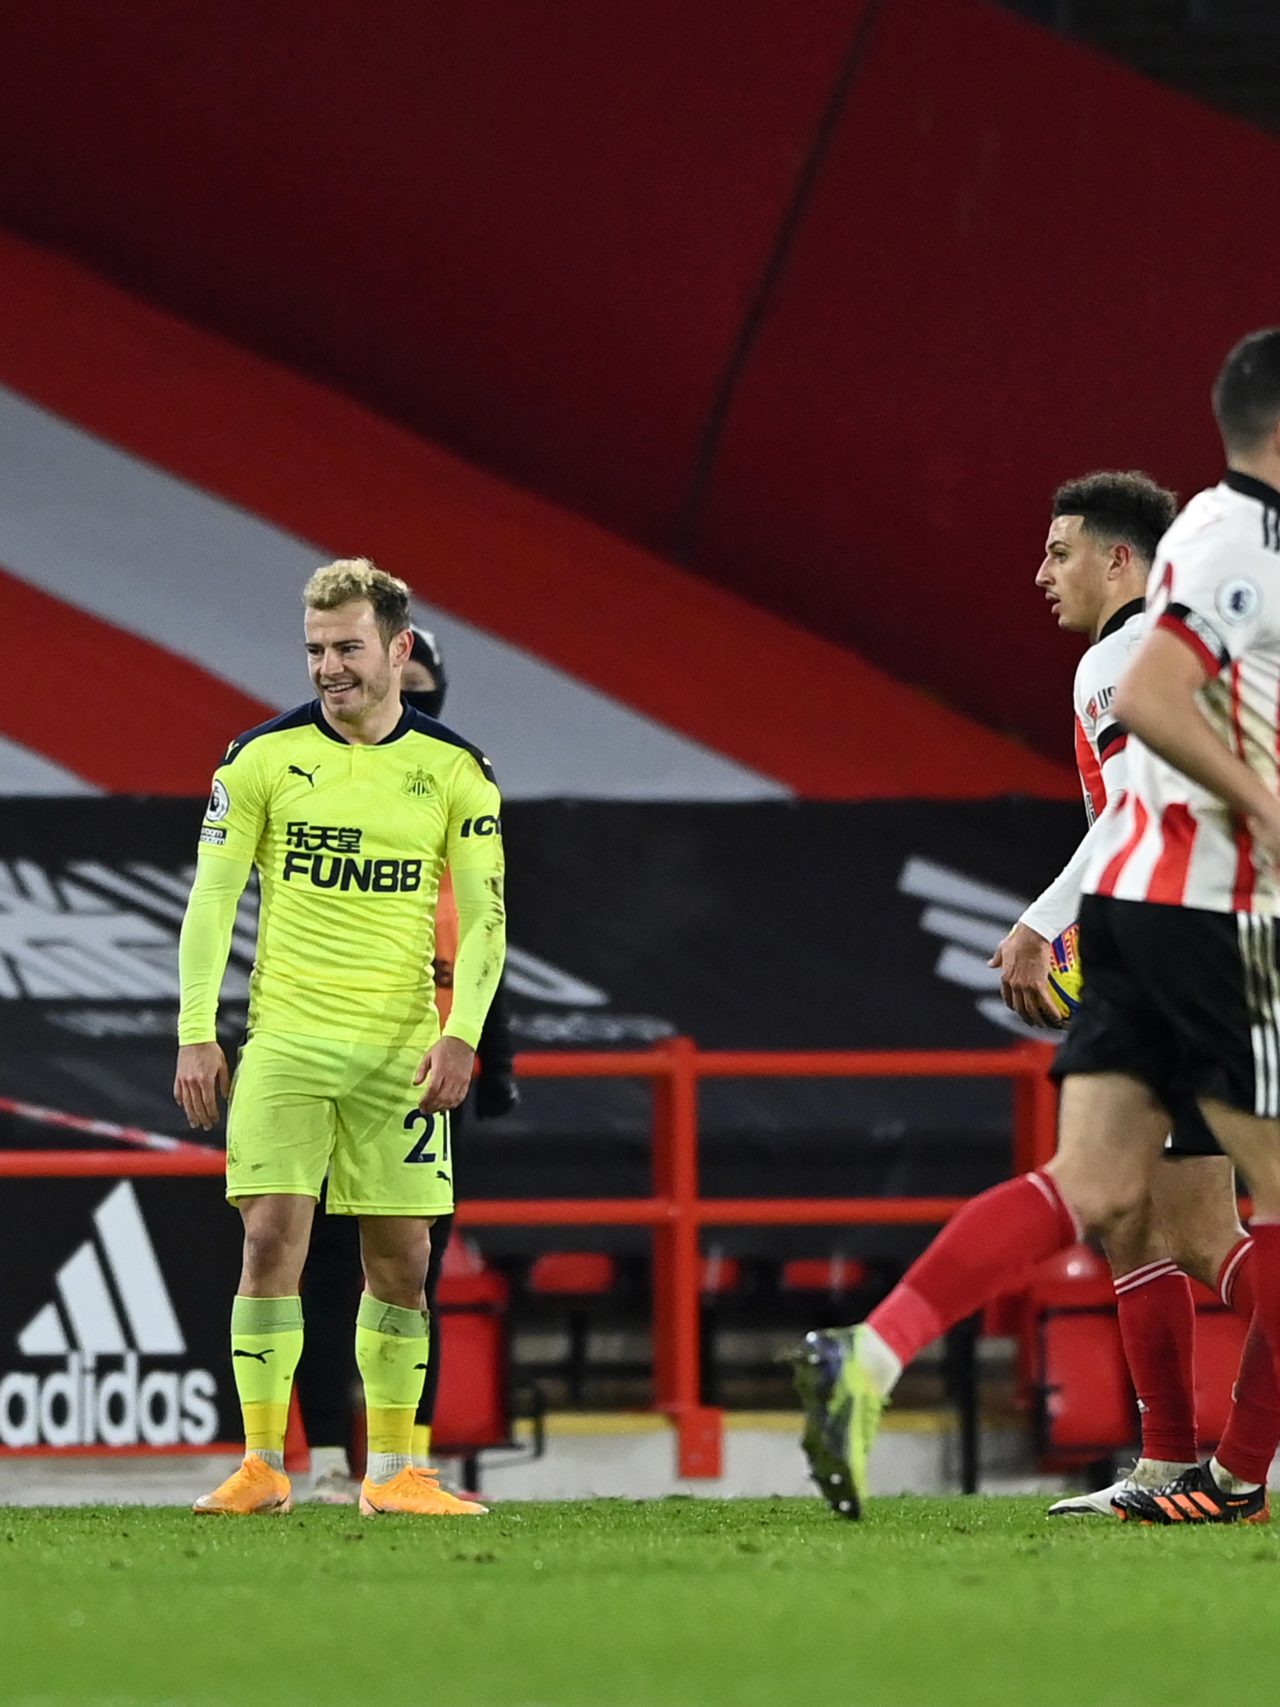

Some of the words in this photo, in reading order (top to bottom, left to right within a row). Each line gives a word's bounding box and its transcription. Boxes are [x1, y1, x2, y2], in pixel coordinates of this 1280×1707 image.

[286, 821, 363, 854] 乐天堂
[460, 815, 502, 838] IC
[282, 851, 423, 893] FUN88
[403, 1108, 449, 1164] 21
[0, 1350, 220, 1447] adidas
